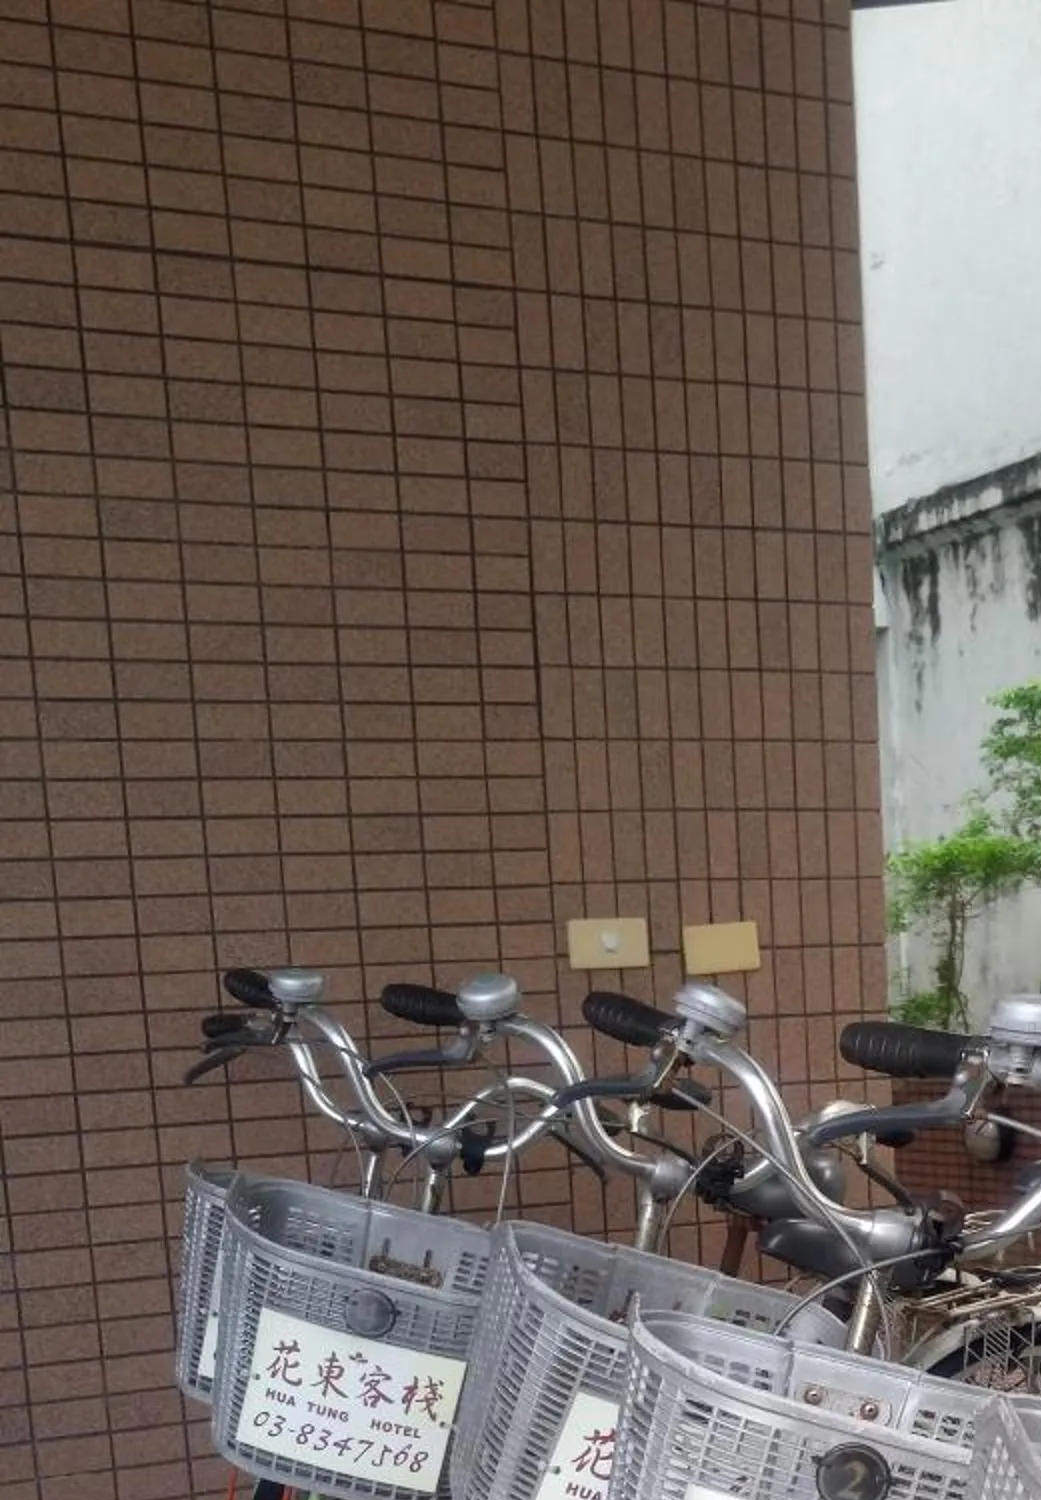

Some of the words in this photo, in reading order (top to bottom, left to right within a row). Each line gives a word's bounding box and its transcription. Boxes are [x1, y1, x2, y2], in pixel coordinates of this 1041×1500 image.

[266, 1388, 297, 1408] HUA
[306, 1401, 350, 1424] TUNG
[370, 1417, 423, 1439] HOTEL
[253, 1411, 429, 1473] 03-8347568
[571, 1428, 616, 1481] 花
[836, 1460, 868, 1500] 2
